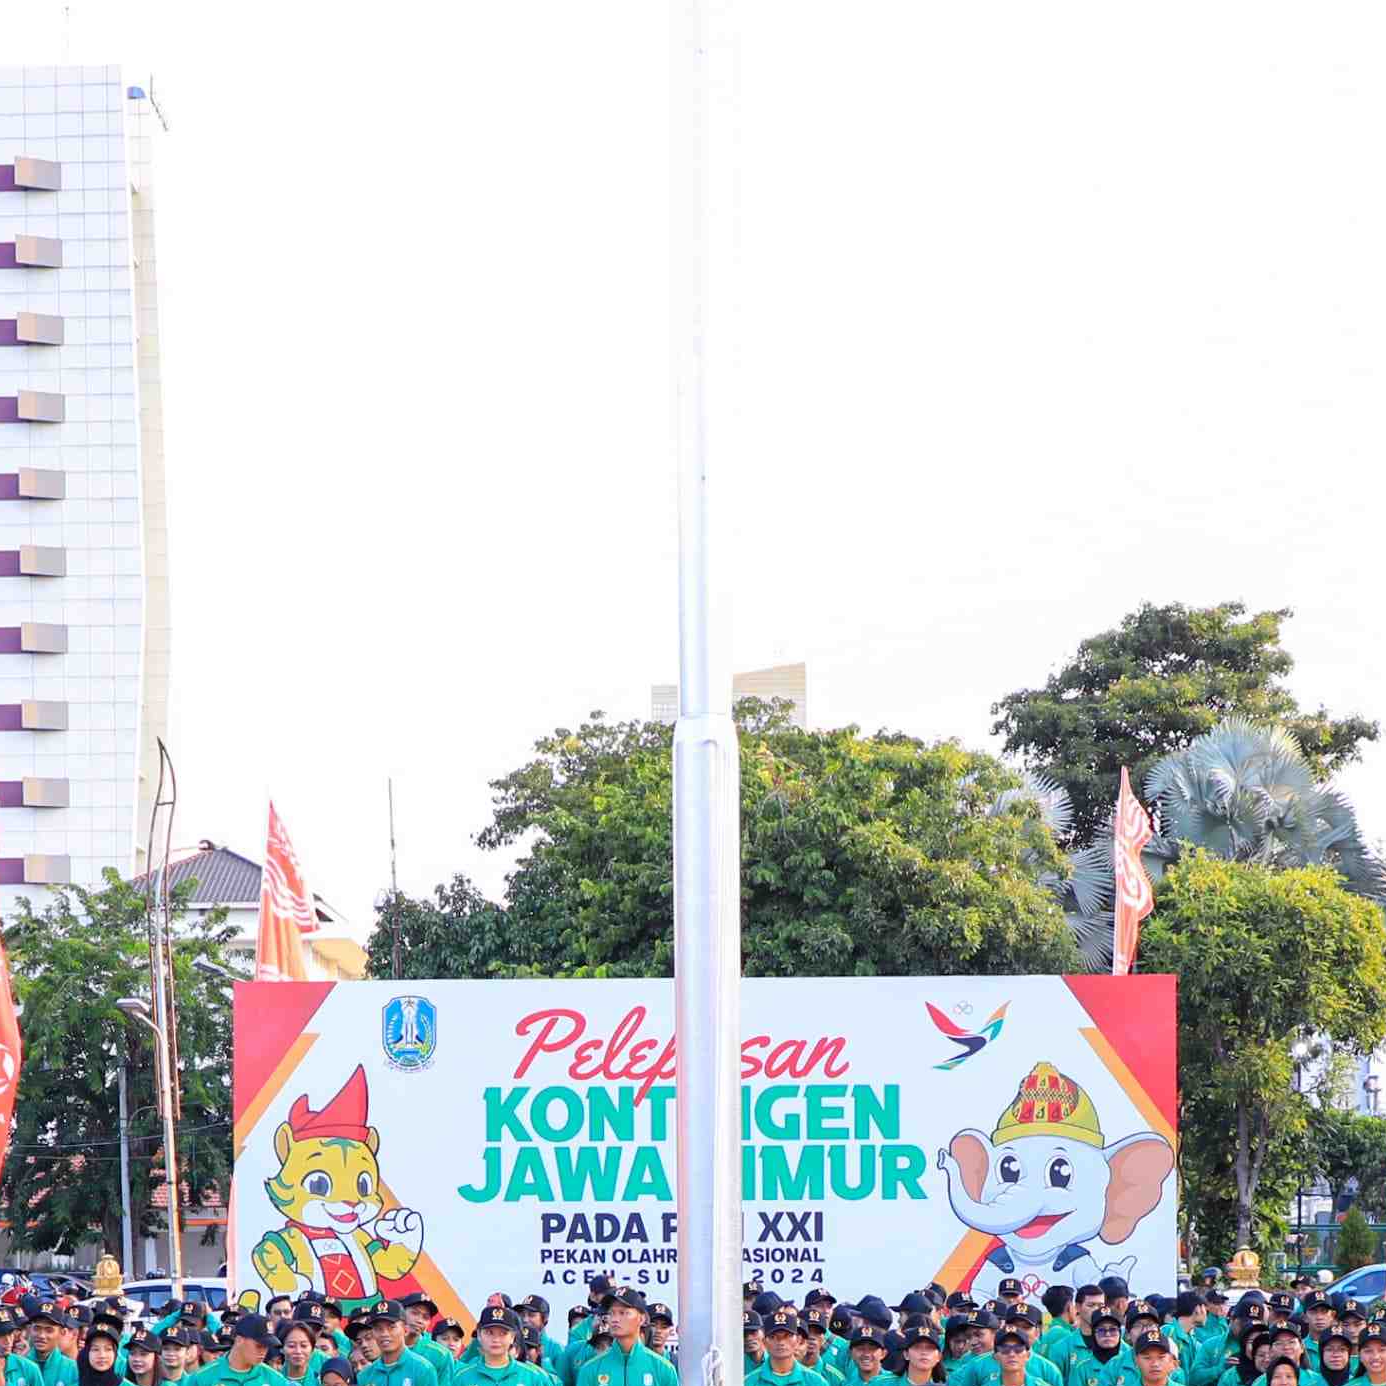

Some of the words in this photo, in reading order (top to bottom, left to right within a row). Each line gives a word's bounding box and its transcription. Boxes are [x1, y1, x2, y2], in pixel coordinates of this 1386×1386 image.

[514, 1006, 849, 1107] Pelepsan
[483, 1085, 900, 1142] KONTGEN
[458, 1146, 673, 1203] JAWA
[741, 1145, 928, 1200] IMUR
[541, 1212, 648, 1243] PADA
[758, 1211, 823, 1242] XXI
[541, 1249, 605, 1264] PEKAN
[613, 1248, 677, 1263] OLAHR
[742, 1248, 825, 1262] ASIONAL
[752, 1268, 824, 1284] 2024
